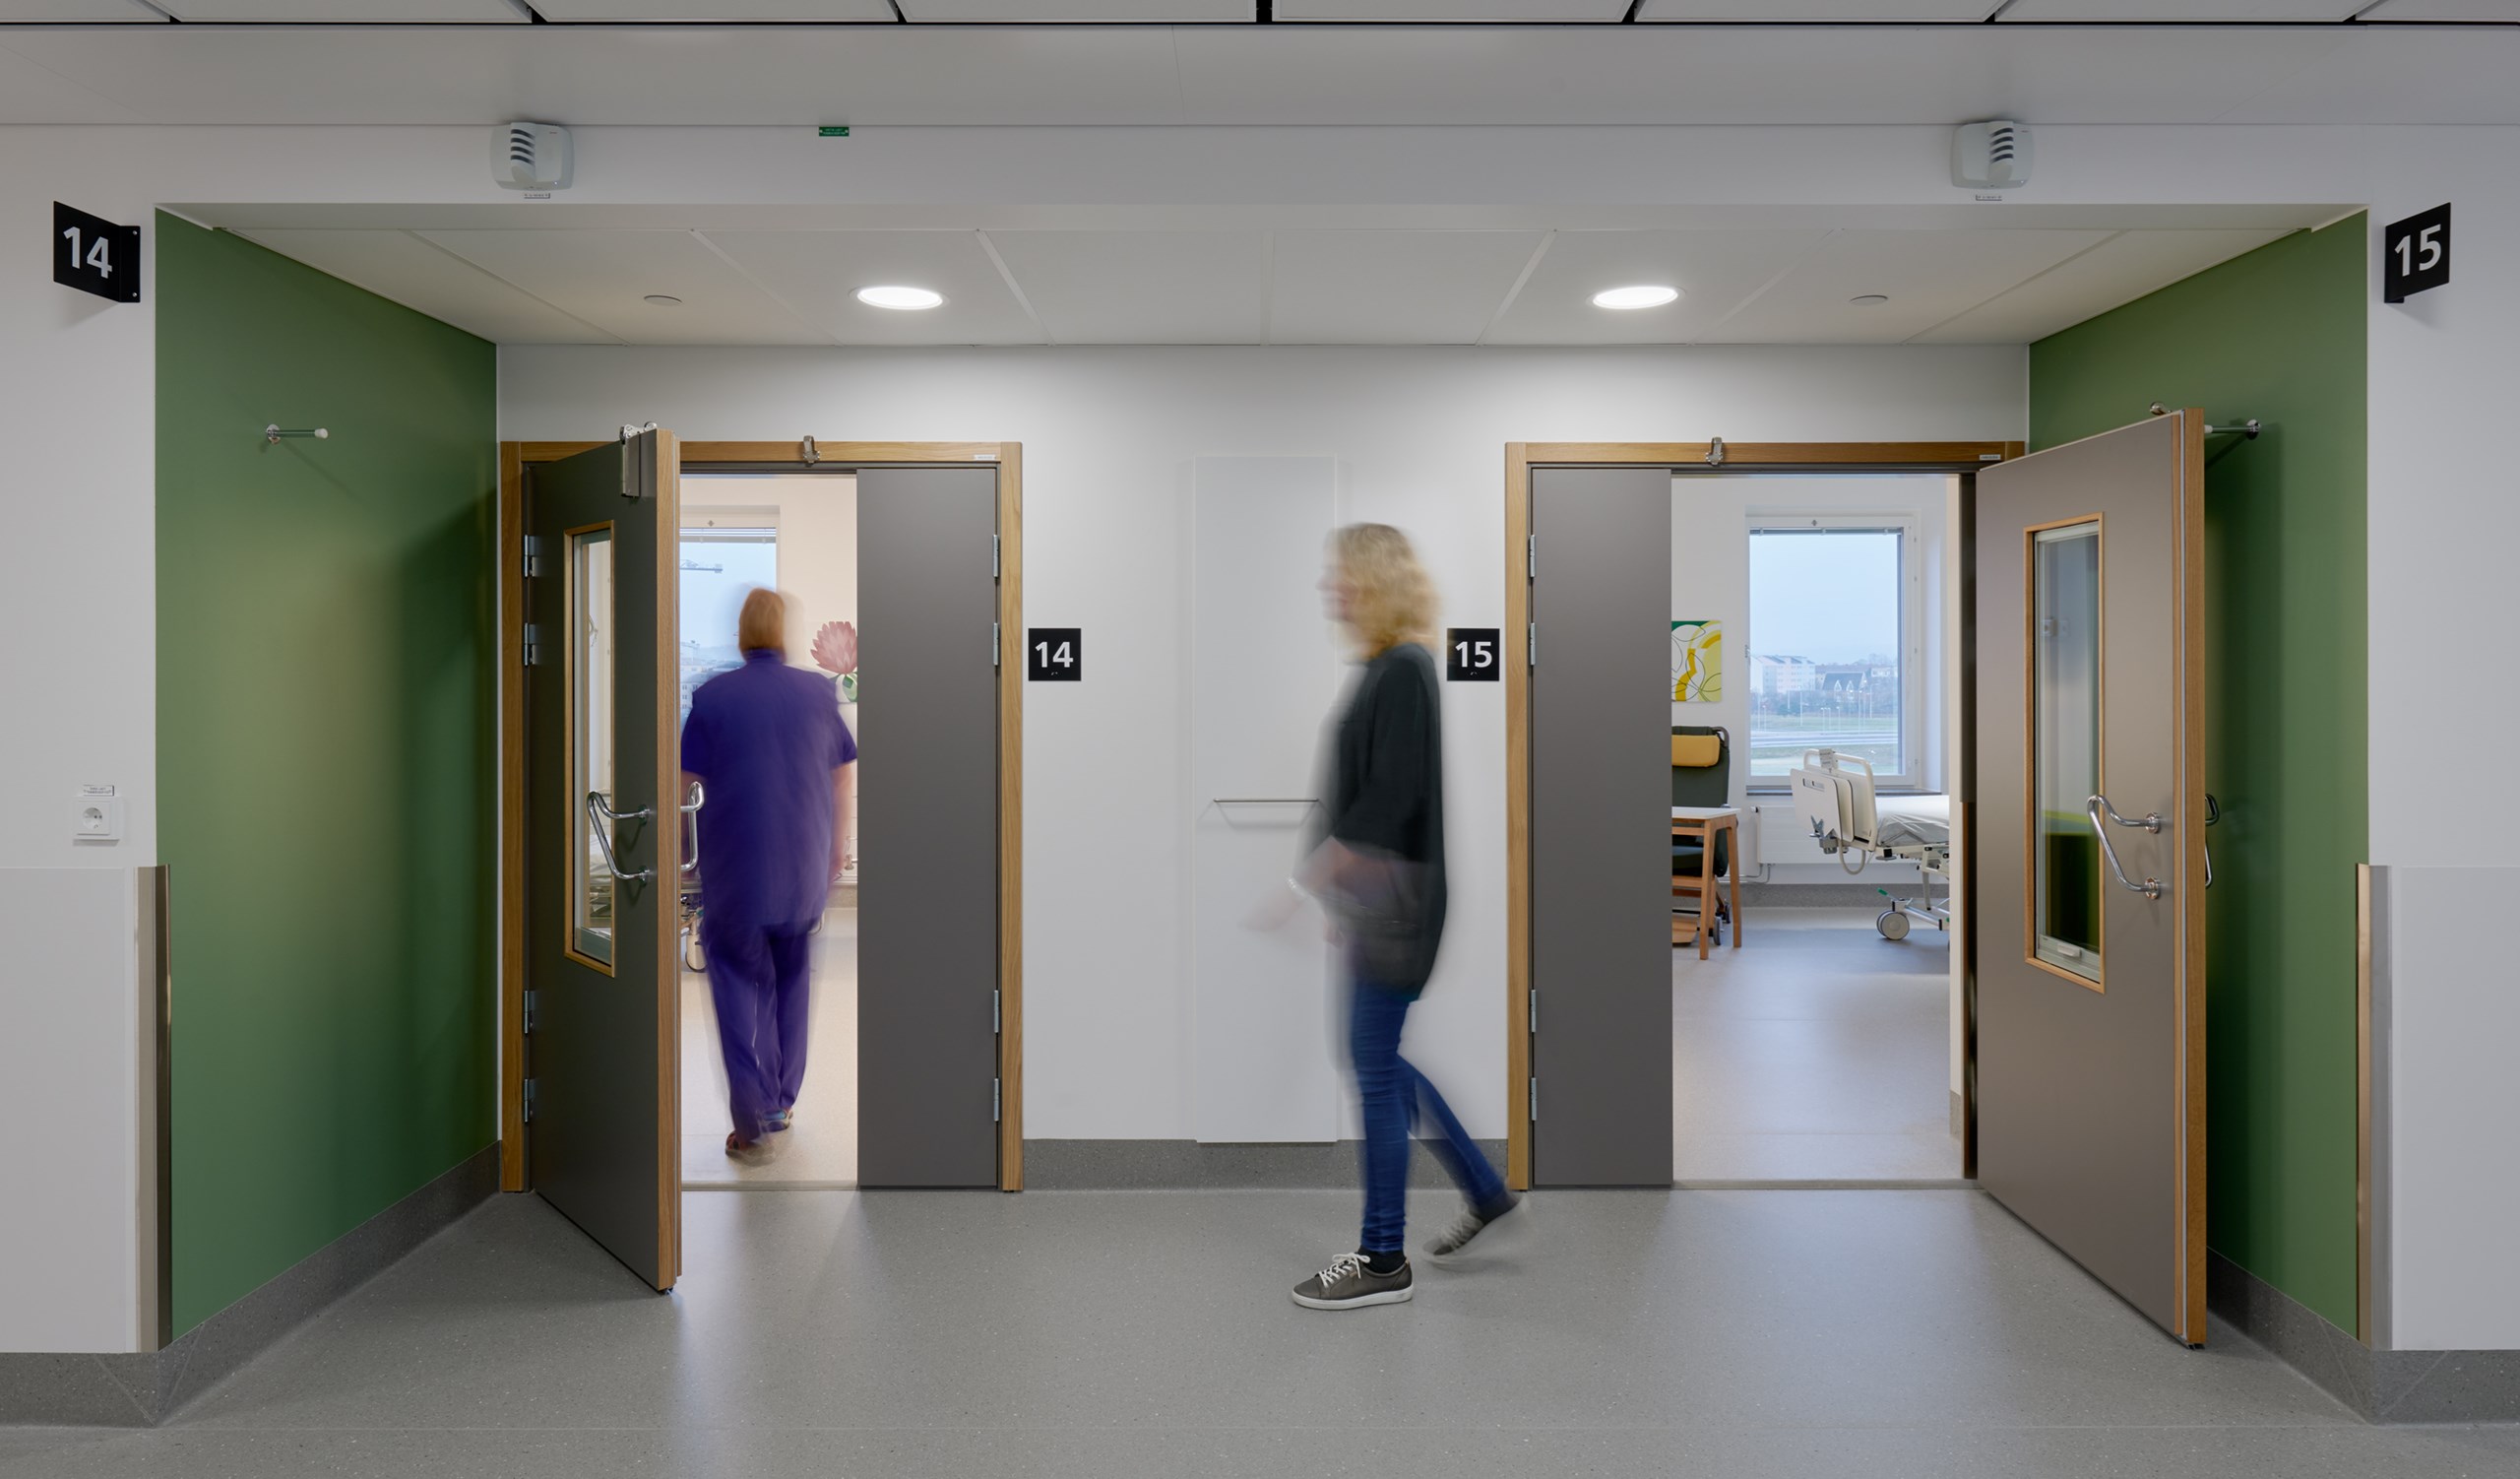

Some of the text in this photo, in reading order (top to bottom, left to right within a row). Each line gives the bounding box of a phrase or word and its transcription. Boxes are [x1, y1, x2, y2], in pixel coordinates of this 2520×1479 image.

[63, 225, 112, 279] 14
[2394, 224, 2441, 277] 15
[1035, 641, 1074, 668] 14
[1455, 641, 1492, 668] 15
